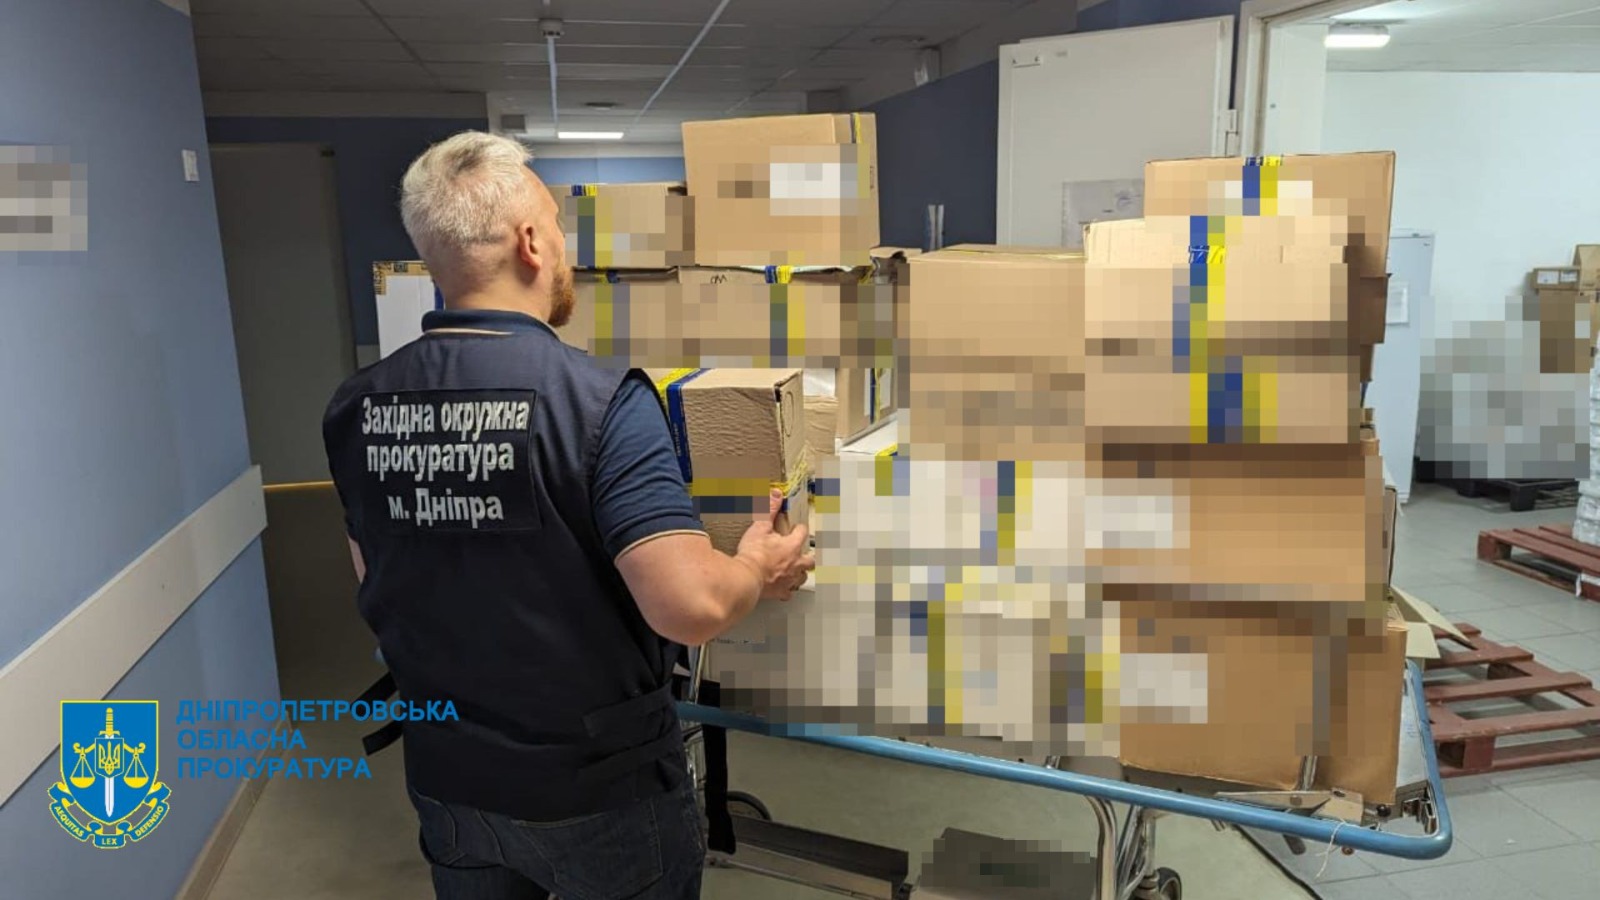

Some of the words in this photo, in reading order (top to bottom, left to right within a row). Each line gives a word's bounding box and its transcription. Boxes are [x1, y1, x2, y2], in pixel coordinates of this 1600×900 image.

[362, 395, 435, 440] Західна
[441, 401, 529, 441] окружна
[367, 442, 514, 481] прокуратура
[387, 495, 410, 519] м.
[415, 488, 504, 529] Дніпра
